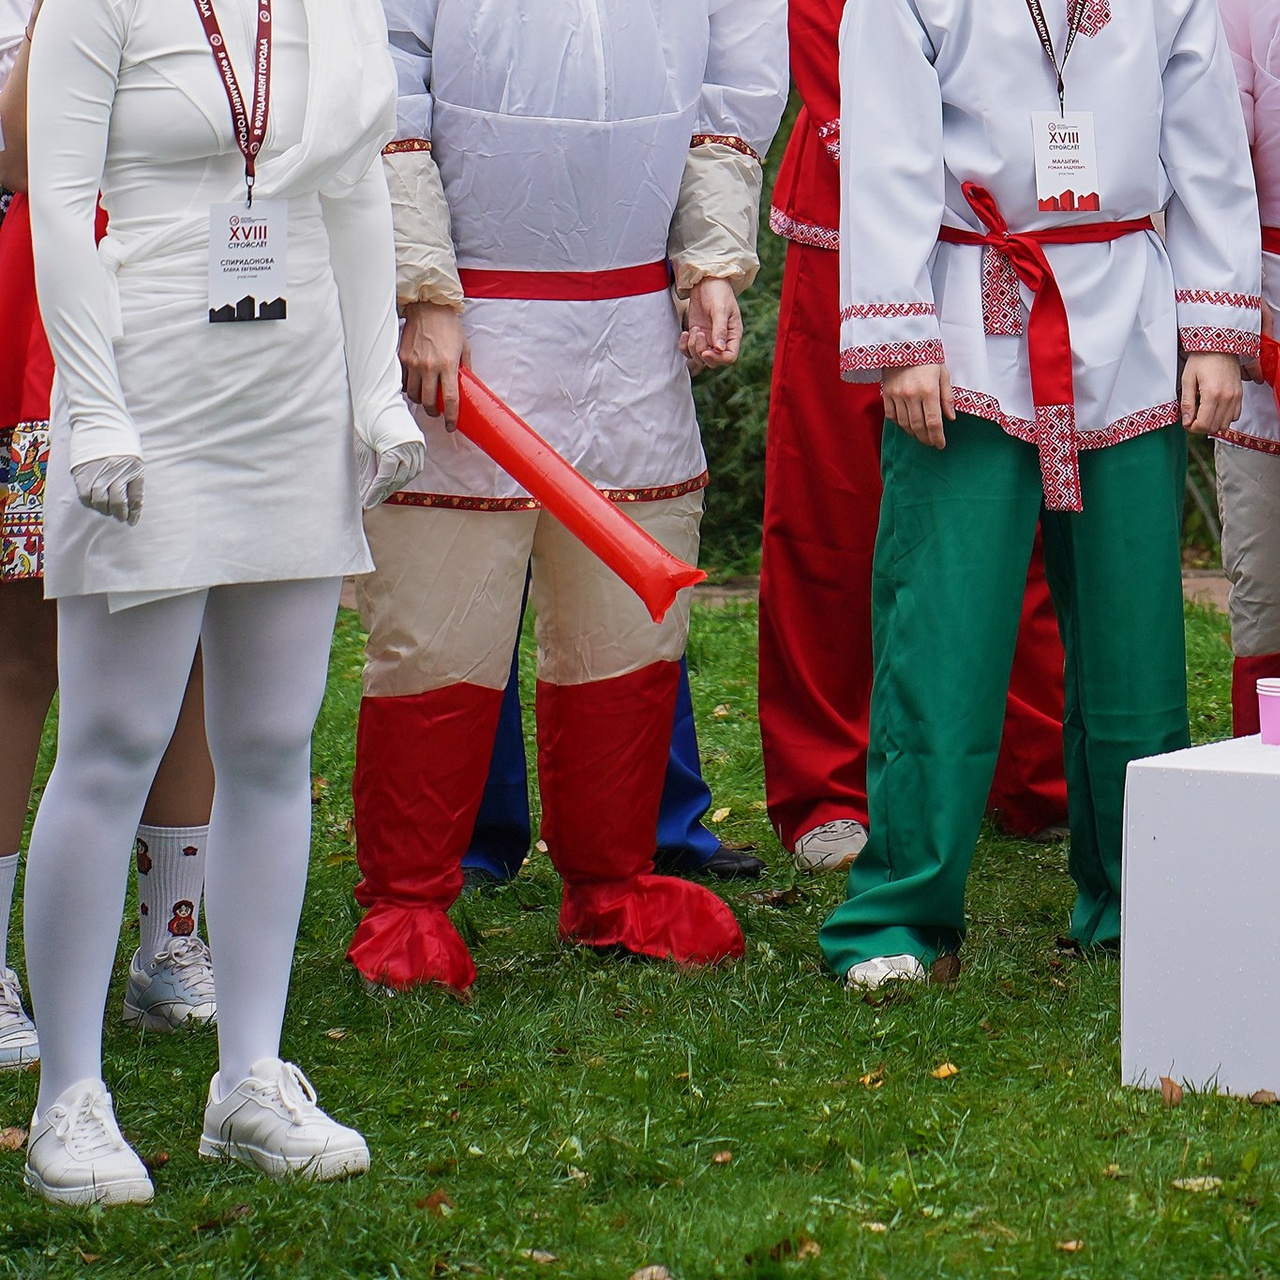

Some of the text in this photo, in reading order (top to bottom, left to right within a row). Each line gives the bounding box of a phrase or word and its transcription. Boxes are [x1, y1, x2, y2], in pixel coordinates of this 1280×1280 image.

[258, 38, 268, 74] ГОРОДА
[220, 59, 243, 114] ФУНДАМЕНТ
[254, 73, 267, 129] ФУНДАМЕНТ
[1048, 131, 1079, 144] XVIII
[228, 225, 268, 241] XVIII
[220, 257, 275, 267] СПИРИДОНОВА
